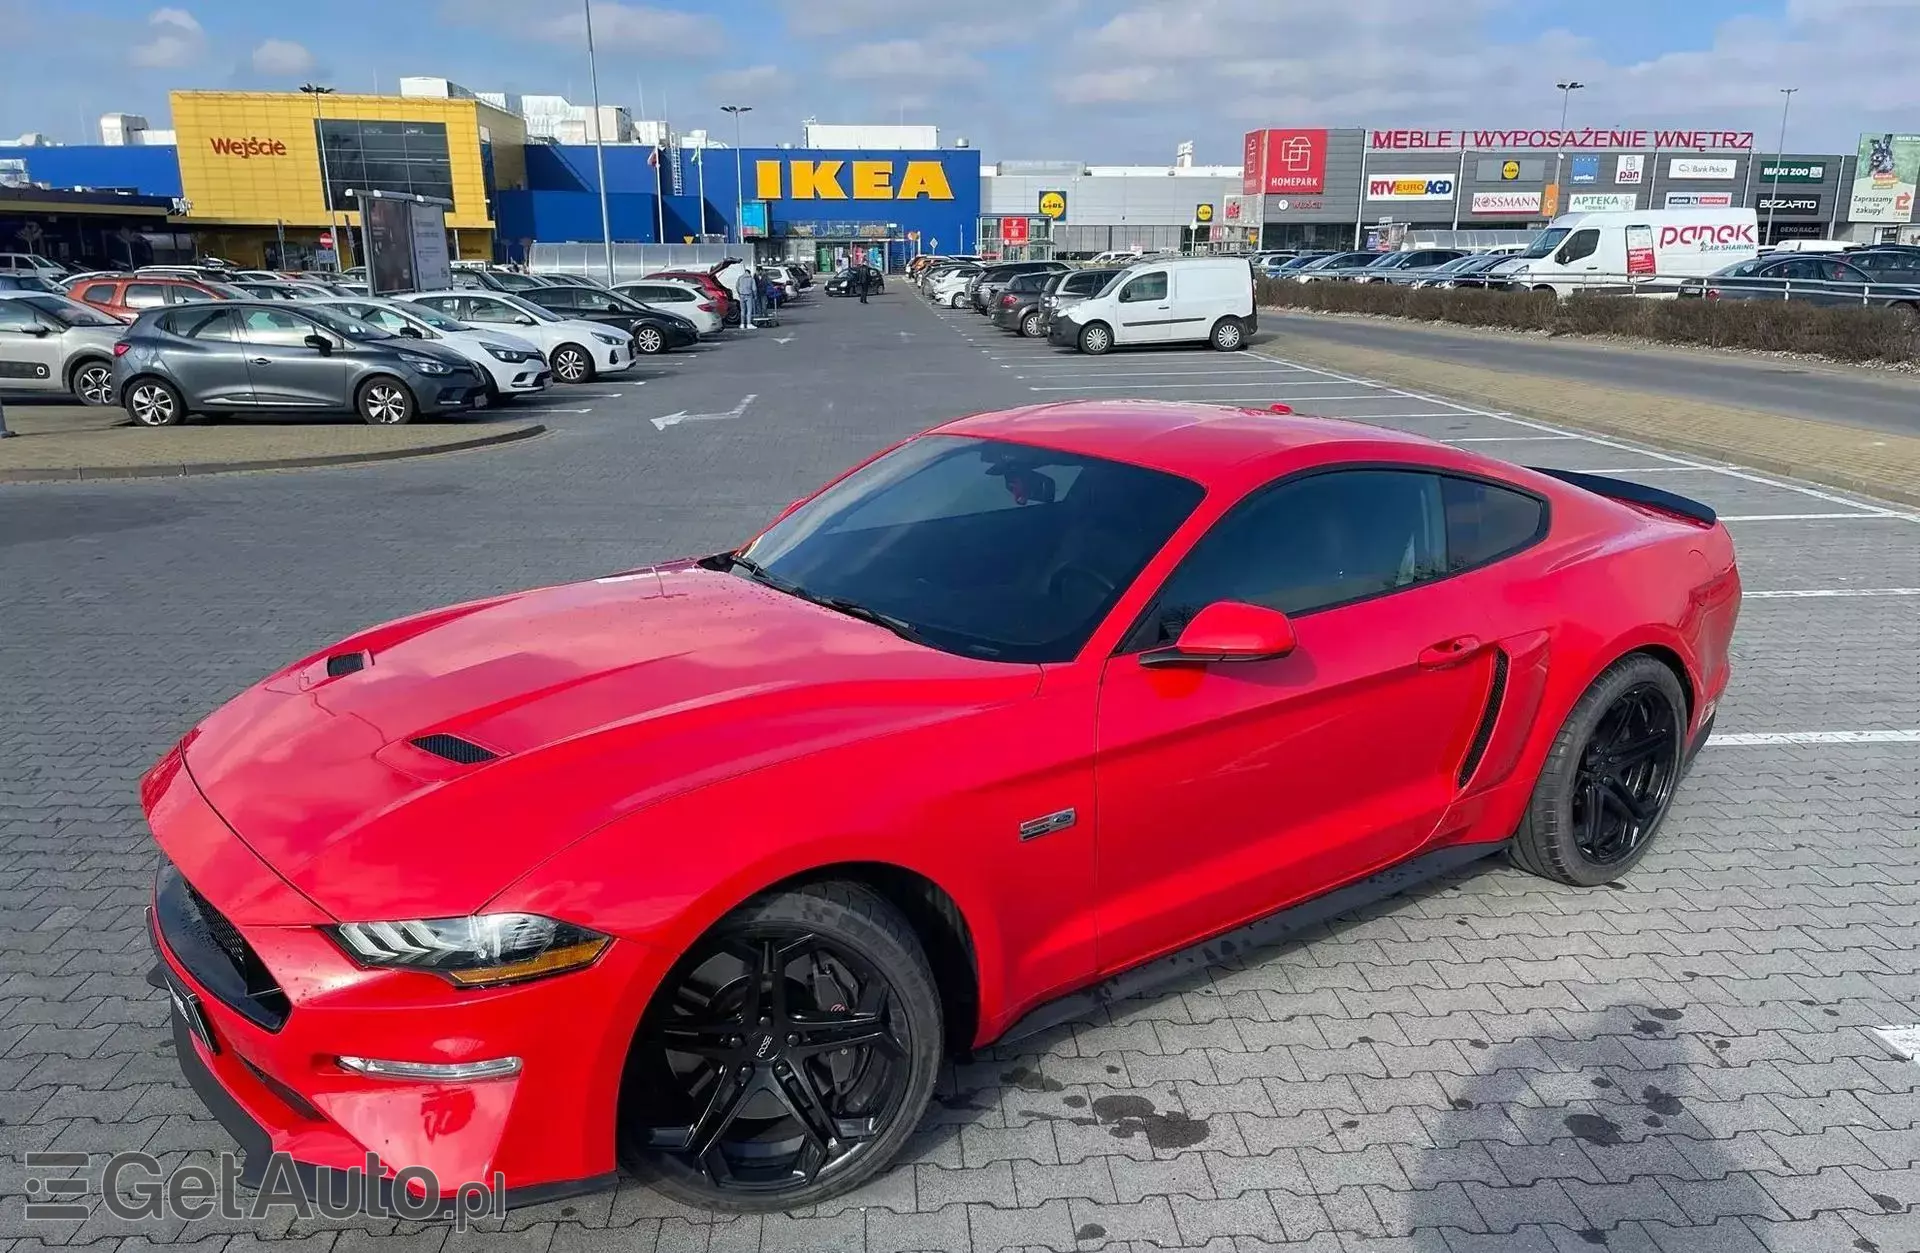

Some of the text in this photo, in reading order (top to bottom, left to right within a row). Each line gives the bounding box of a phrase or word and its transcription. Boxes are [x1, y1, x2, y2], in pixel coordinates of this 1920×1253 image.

[1372, 127, 1754, 152] MEBLE I WYPOSAŻENIE WNĘTRZ
[209, 136, 287, 159] Wejście
[1692, 165, 1707, 173] Bank
[1763, 167, 1809, 176] MAXI ZOO
[756, 160, 954, 200] IKEA
[1619, 171, 1639, 182] pan
[1271, 177, 1318, 187] HOMEPARK
[1370, 180, 1452, 195] RTV EURO AGD
[1473, 196, 1540, 208] ROSSMANN
[1573, 196, 1619, 205] APTEKA
[1759, 200, 1816, 209] BIZZARTO
[1853, 195, 1893, 204] Zapraszamy
[1856, 206, 1884, 216] zakupy!
[1660, 224, 1755, 249] panek
